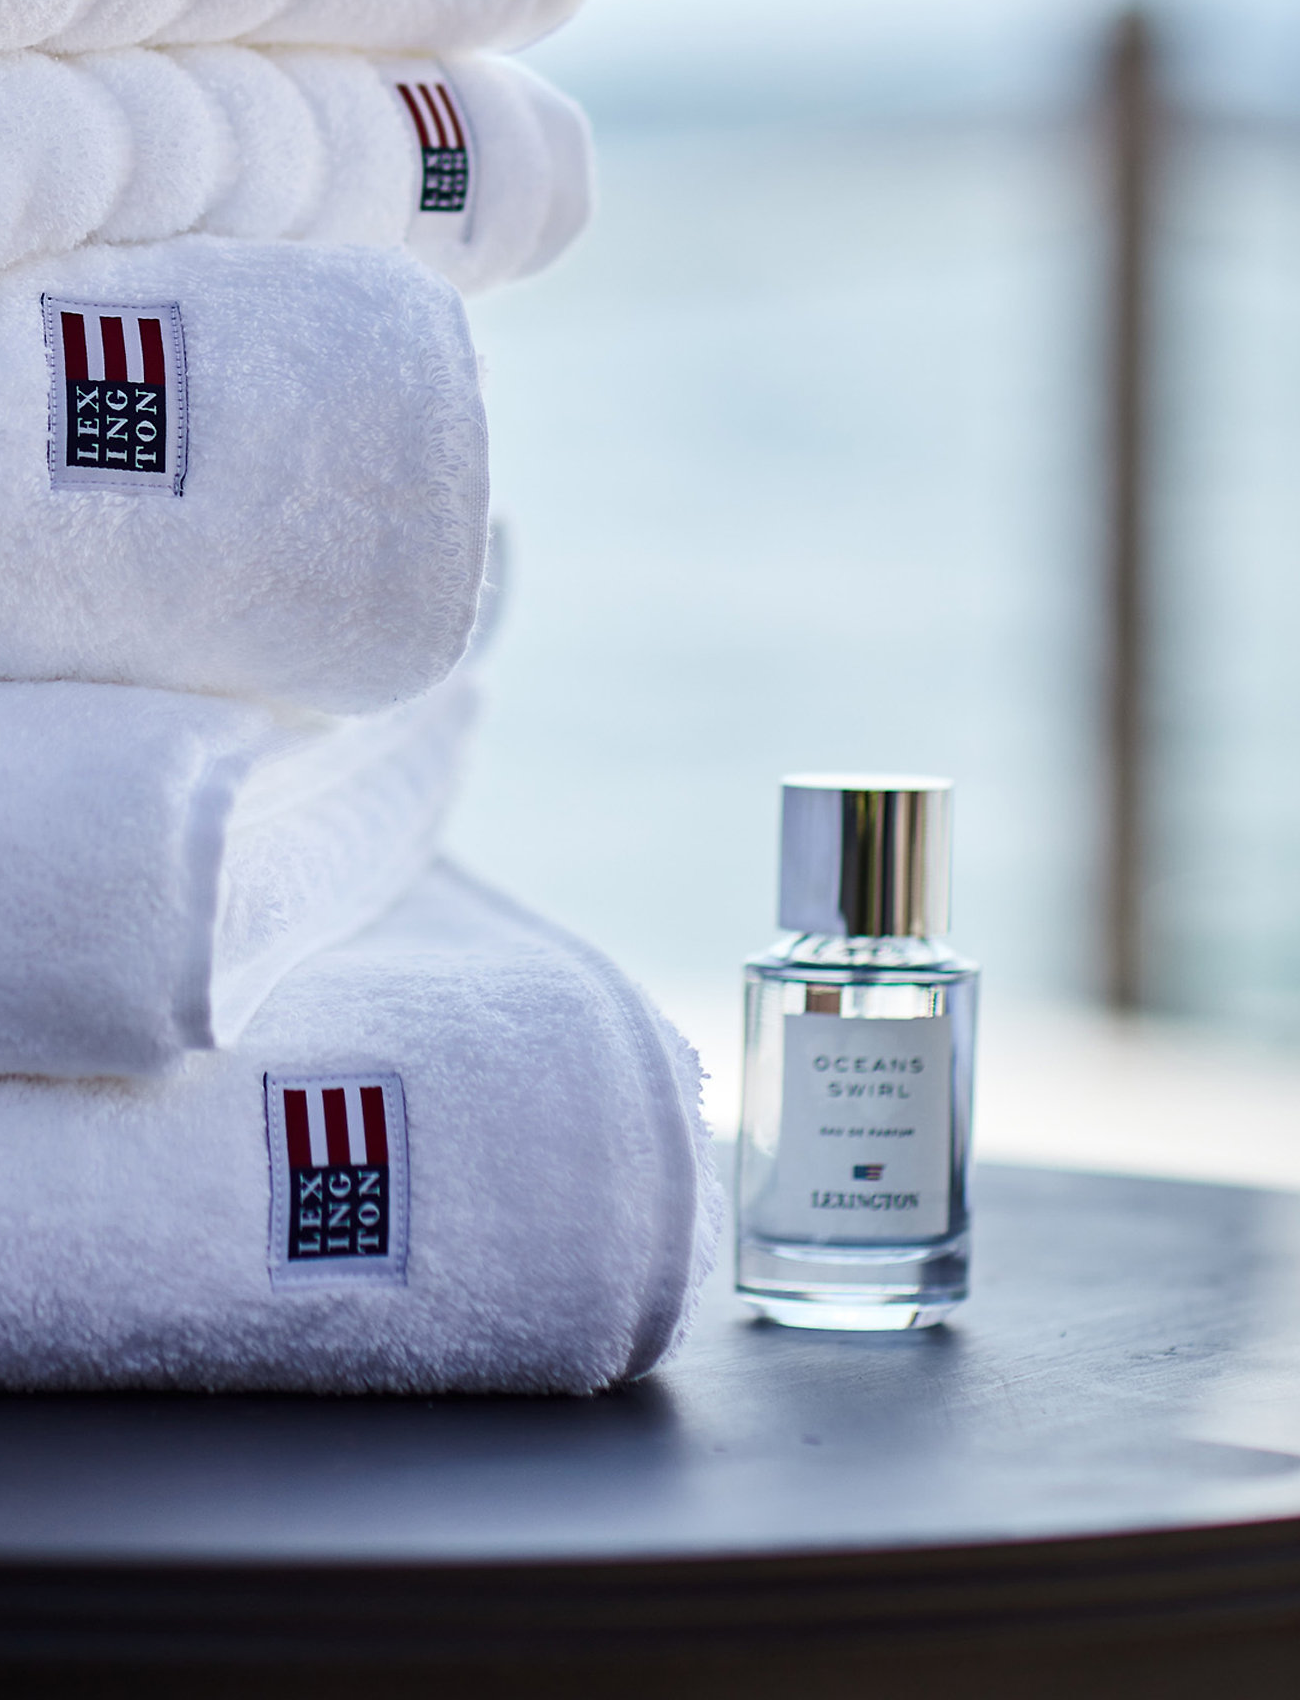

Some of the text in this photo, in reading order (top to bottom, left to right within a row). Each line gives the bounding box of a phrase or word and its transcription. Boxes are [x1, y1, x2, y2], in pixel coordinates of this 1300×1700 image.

[76, 386, 99, 462] LEX
[105, 389, 128, 462] ING
[135, 388, 157, 469] TON
[812, 1055, 925, 1074] OCEANS
[827, 1082, 910, 1099] SWIRL
[298, 1172, 323, 1255] LEX
[327, 1172, 351, 1252] ING
[357, 1171, 380, 1254] TON
[811, 1190, 921, 1211] LEXINGTON
